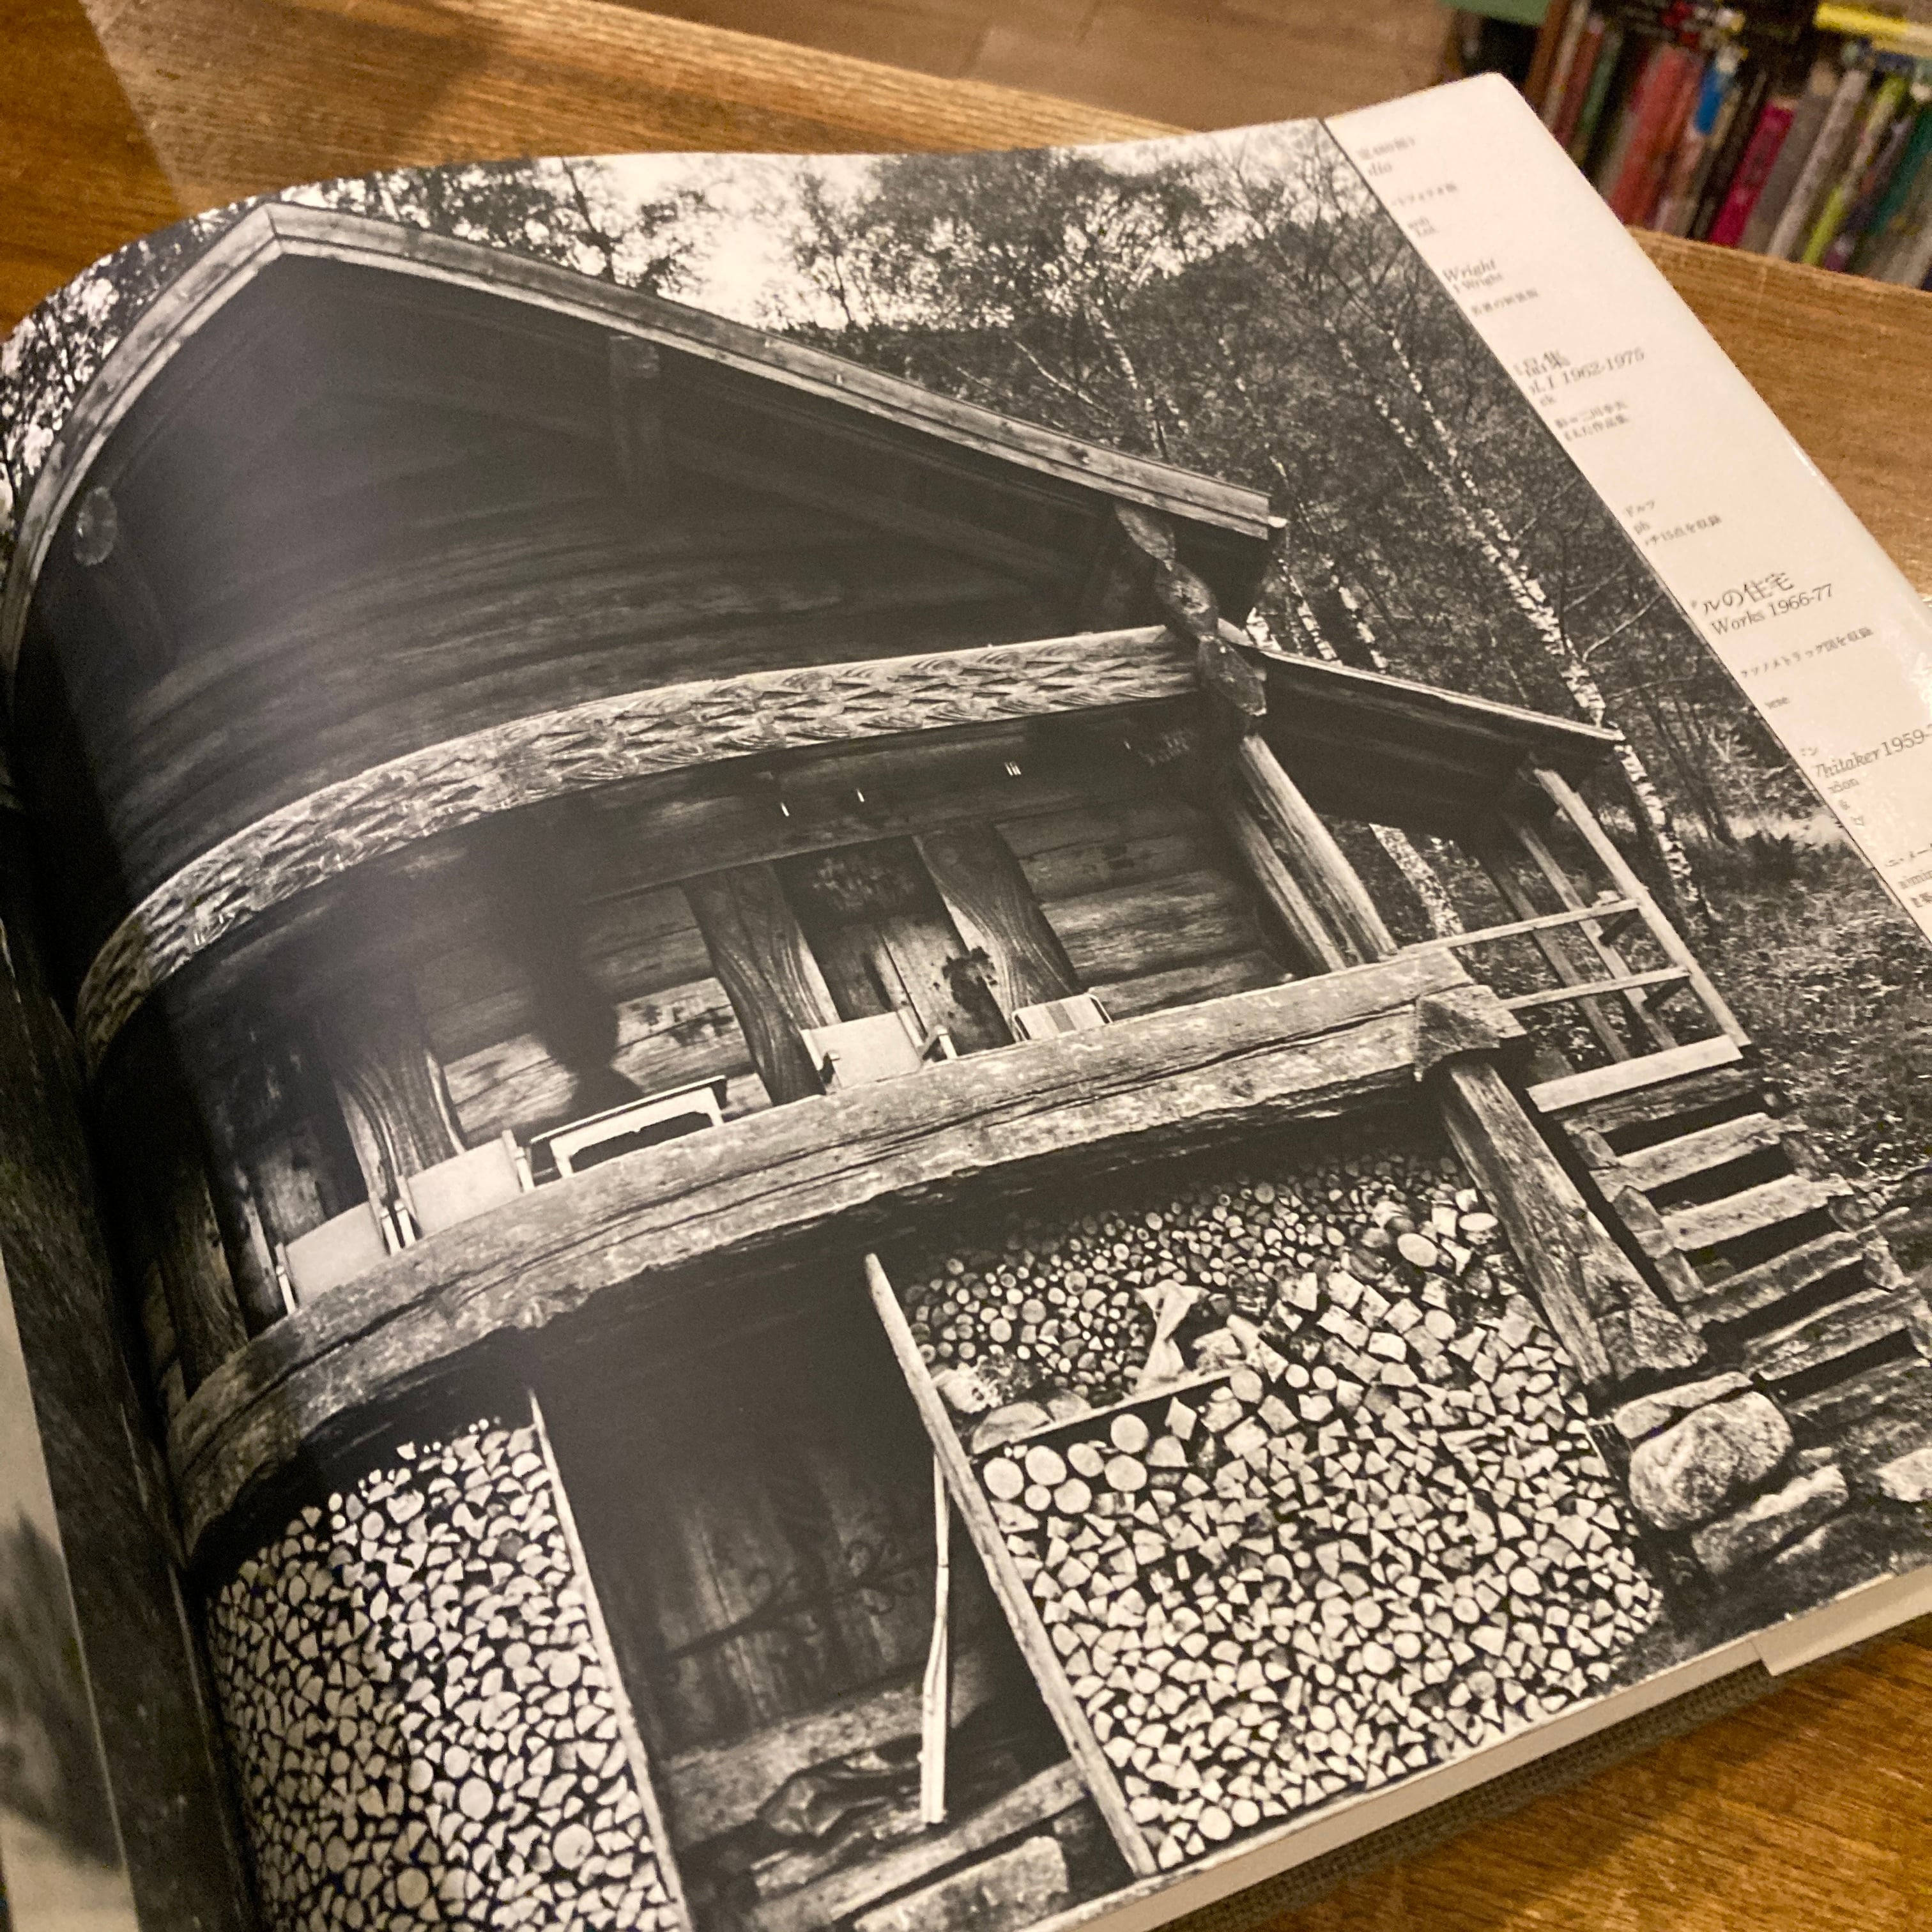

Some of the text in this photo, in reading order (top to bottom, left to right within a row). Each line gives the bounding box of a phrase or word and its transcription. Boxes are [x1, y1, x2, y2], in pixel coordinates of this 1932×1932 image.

[1442, 257, 1496, 282] Wright
[1692, 572, 1795, 615] ルの住宅
[1710, 583, 1832, 636] Works 1966-77
[1881, 723, 1932, 757] 1959-
